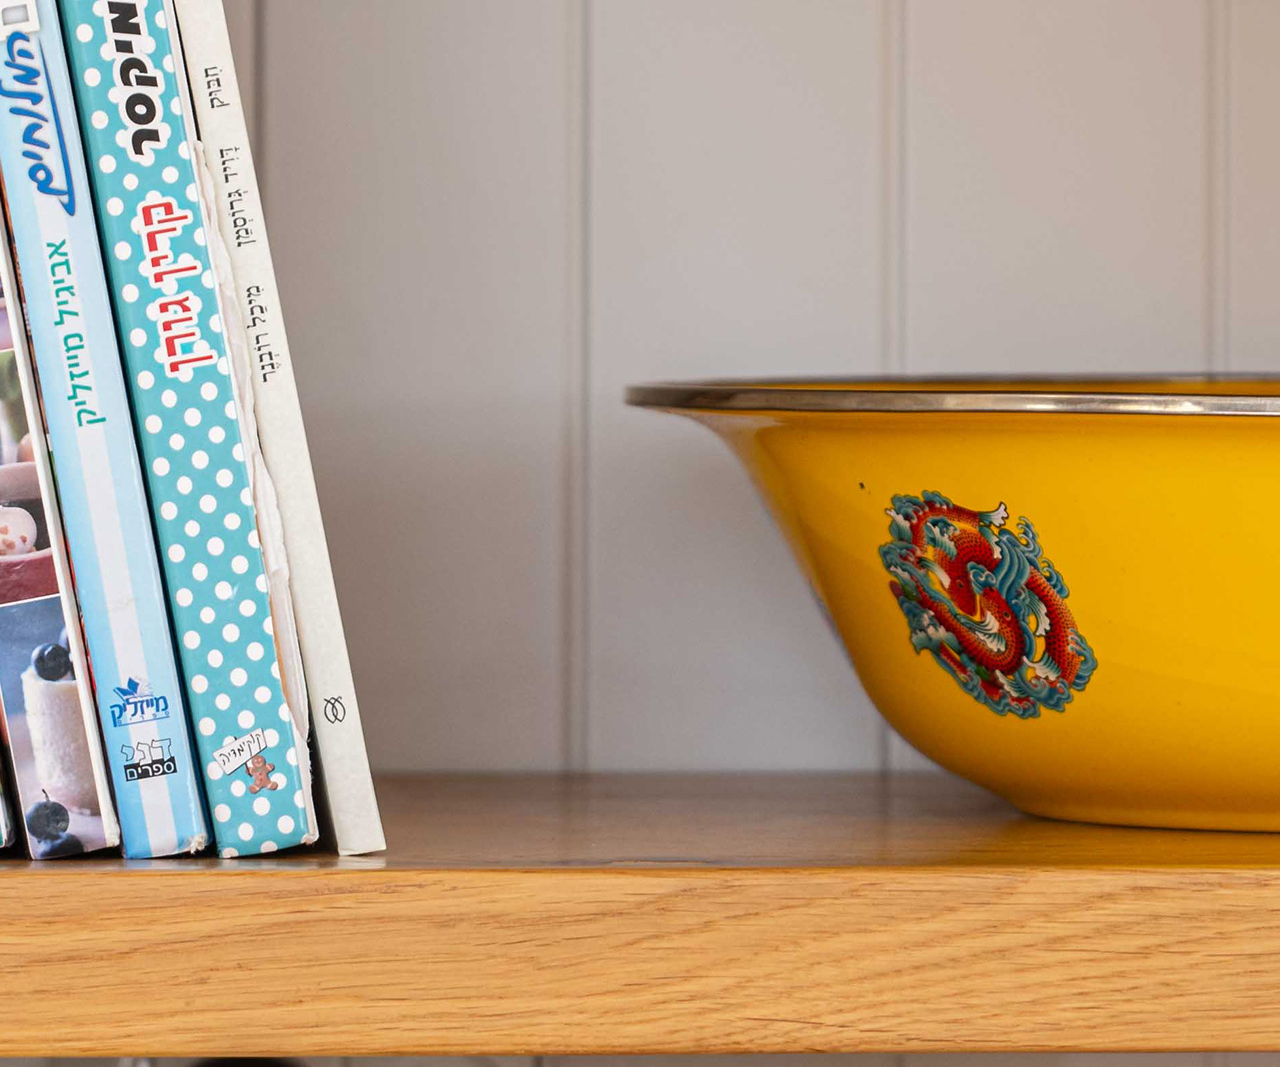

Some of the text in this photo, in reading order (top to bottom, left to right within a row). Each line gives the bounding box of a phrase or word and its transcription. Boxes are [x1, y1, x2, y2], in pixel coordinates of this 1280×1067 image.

[108, 1, 160, 156] מיקסר
[46, 239, 107, 428] אביגיל מייזליק
[142, 203, 213, 372] קרין גורן
[110, 696, 169, 727] מייזליק
[121, 738, 171, 765] דני
[127, 762, 174, 779] ספרים
